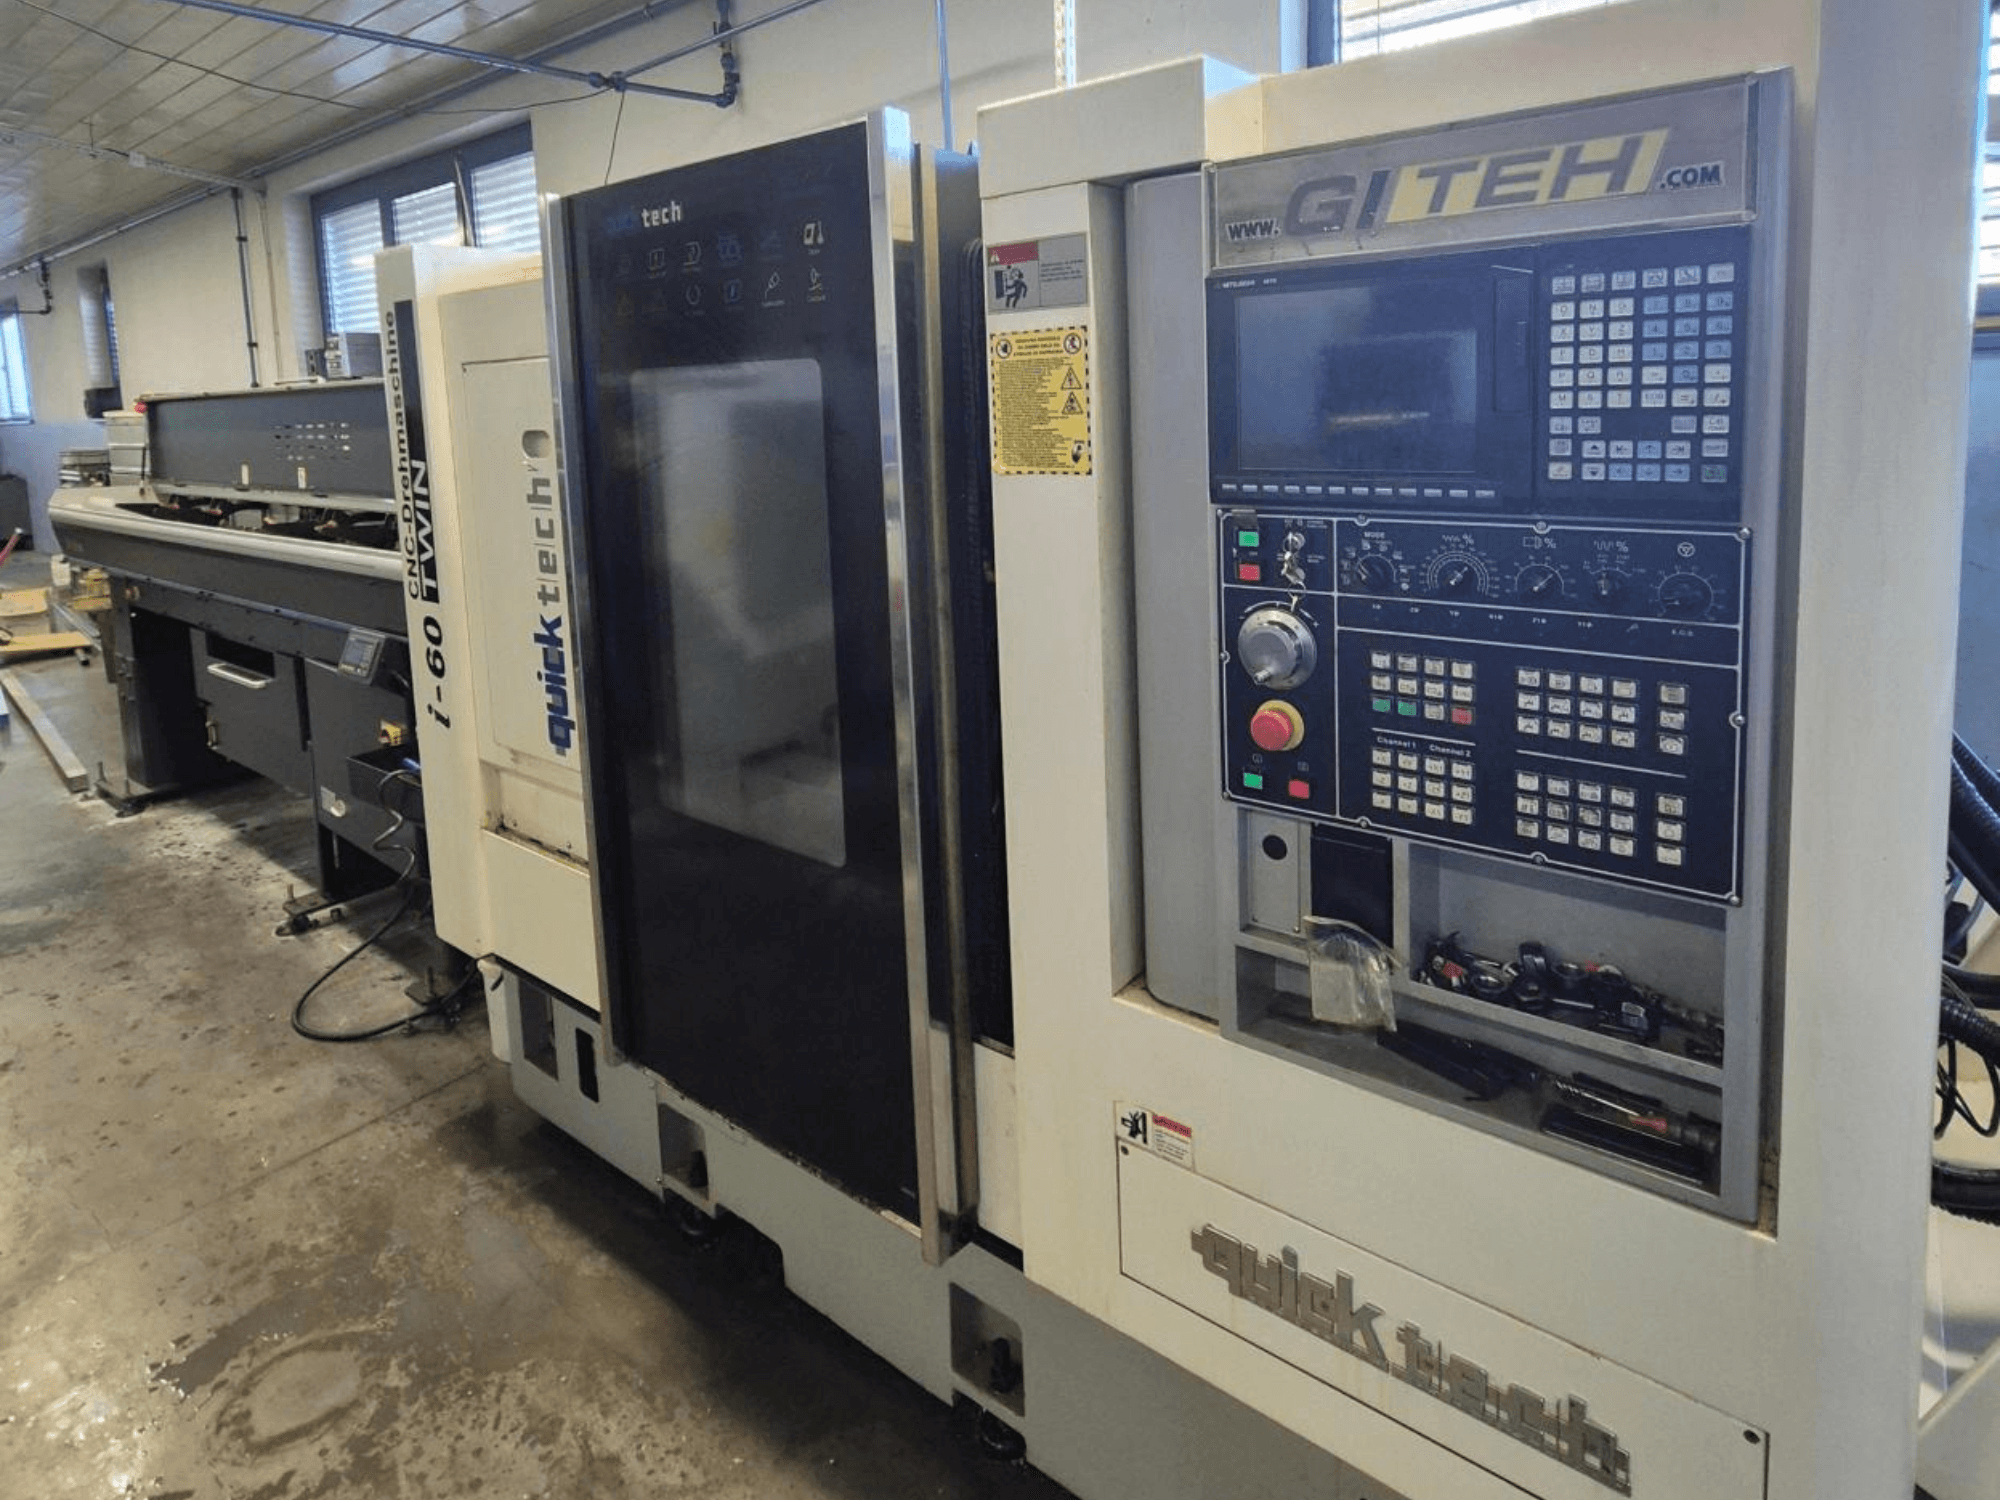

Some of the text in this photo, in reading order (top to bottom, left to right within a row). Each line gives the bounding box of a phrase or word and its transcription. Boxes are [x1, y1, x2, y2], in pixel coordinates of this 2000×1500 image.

[641, 200, 682, 228] tech
[1285, 133, 1643, 235] GITEH
[384, 309, 420, 600] CNC-Drehmaschine
[411, 459, 453, 730] i-60 TWIN
[527, 477, 575, 757] quick tech
[1376, 735, 1411, 748] Channel
[1428, 743, 1464, 757] Channel
[1190, 1223, 1632, 1497] quick tech
